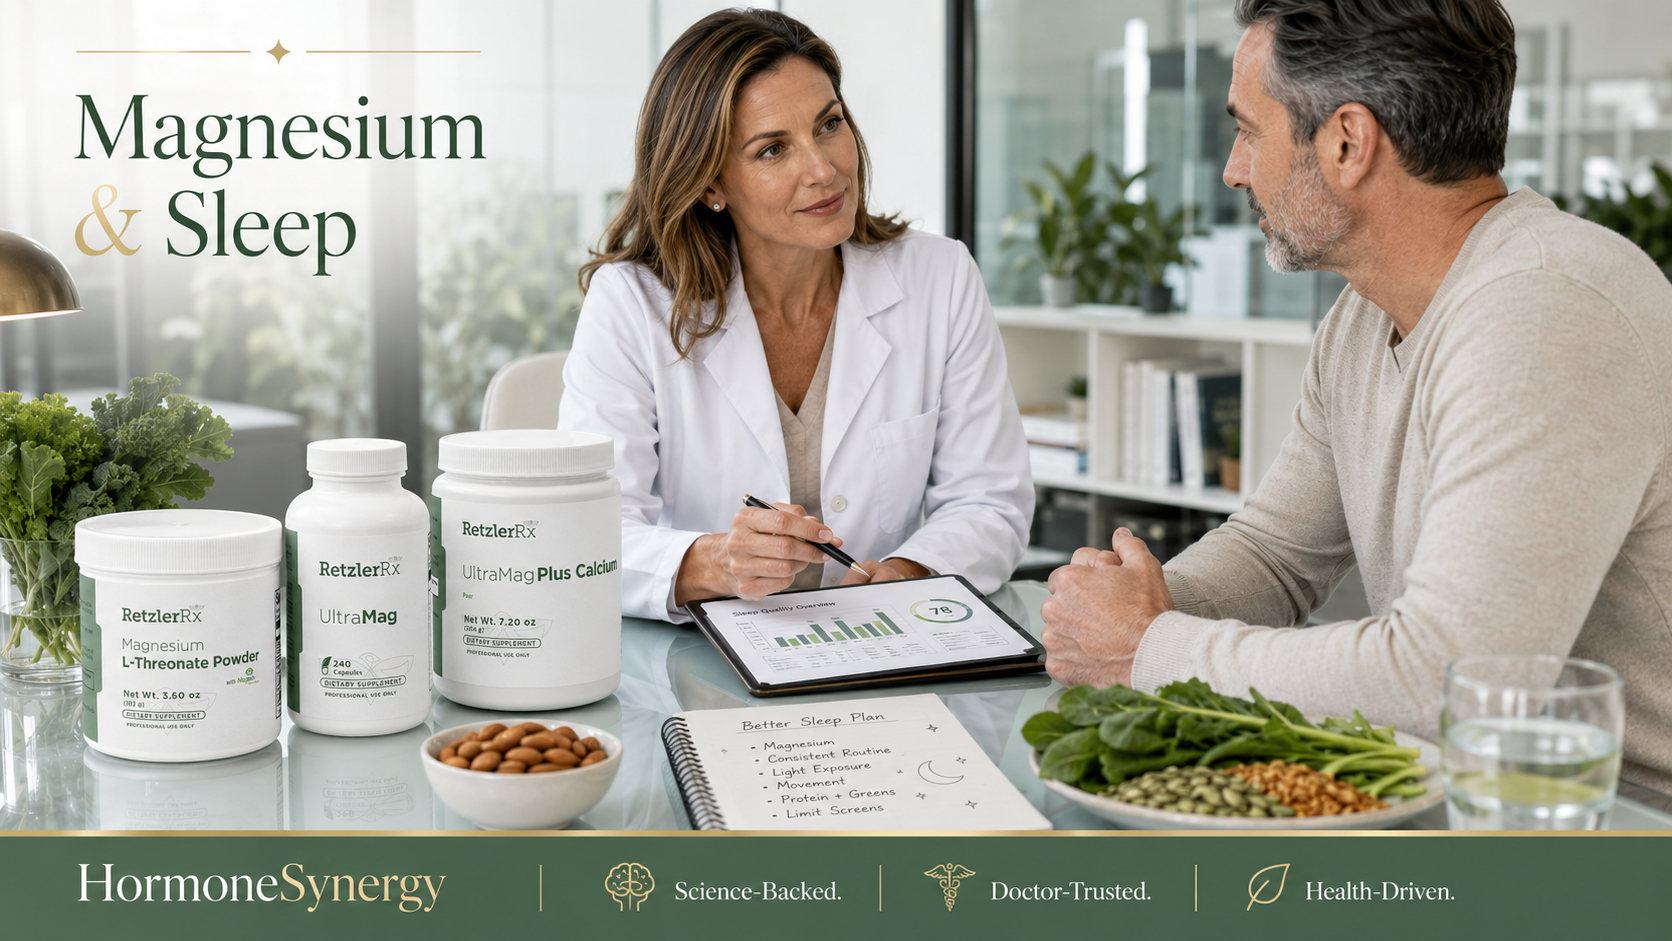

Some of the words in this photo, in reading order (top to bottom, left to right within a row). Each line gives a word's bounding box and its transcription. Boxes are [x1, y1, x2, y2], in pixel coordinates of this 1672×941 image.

[462, 521, 537, 538] RetzlerRx
[319, 560, 400, 578] RetzlerRx
[462, 563, 534, 585] UltraMag
[537, 566, 571, 582] Plus
[576, 558, 618, 579] Calcium
[122, 607, 202, 623] RetzlerRx
[319, 607, 398, 627] UltraMag
[732, 609, 759, 618] Sleep
[760, 605, 793, 614] Quality
[795, 601, 836, 610] Overview
[928, 605, 953, 616] 78
[464, 614, 478, 624] Net
[480, 616, 496, 626] Wt.
[499, 617, 521, 627] 7.20
[122, 637, 204, 654] Magnesium
[122, 655, 209, 671] L-Threonate
[213, 649, 260, 668] Powder
[333, 659, 351, 668] 240
[333, 669, 363, 677] Capsules
[123, 689, 139, 699] Net
[142, 690, 160, 700] Wt.
[162, 691, 185, 700] 3.60
[741, 720, 791, 731] Better
[801, 716, 841, 727] Sleep
[851, 713, 885, 723] Plan
[764, 739, 835, 752] Magnesium
[768, 751, 835, 763] Consistent
[842, 746, 891, 756] Routine
[772, 767, 806, 778] Light
[813, 762, 871, 775] Exposure
[777, 778, 846, 789] Movement
[781, 793, 829, 804] Protein
[849, 788, 896, 798] Greens
[786, 808, 822, 818] Limit
[830, 804, 884, 814] Screens
